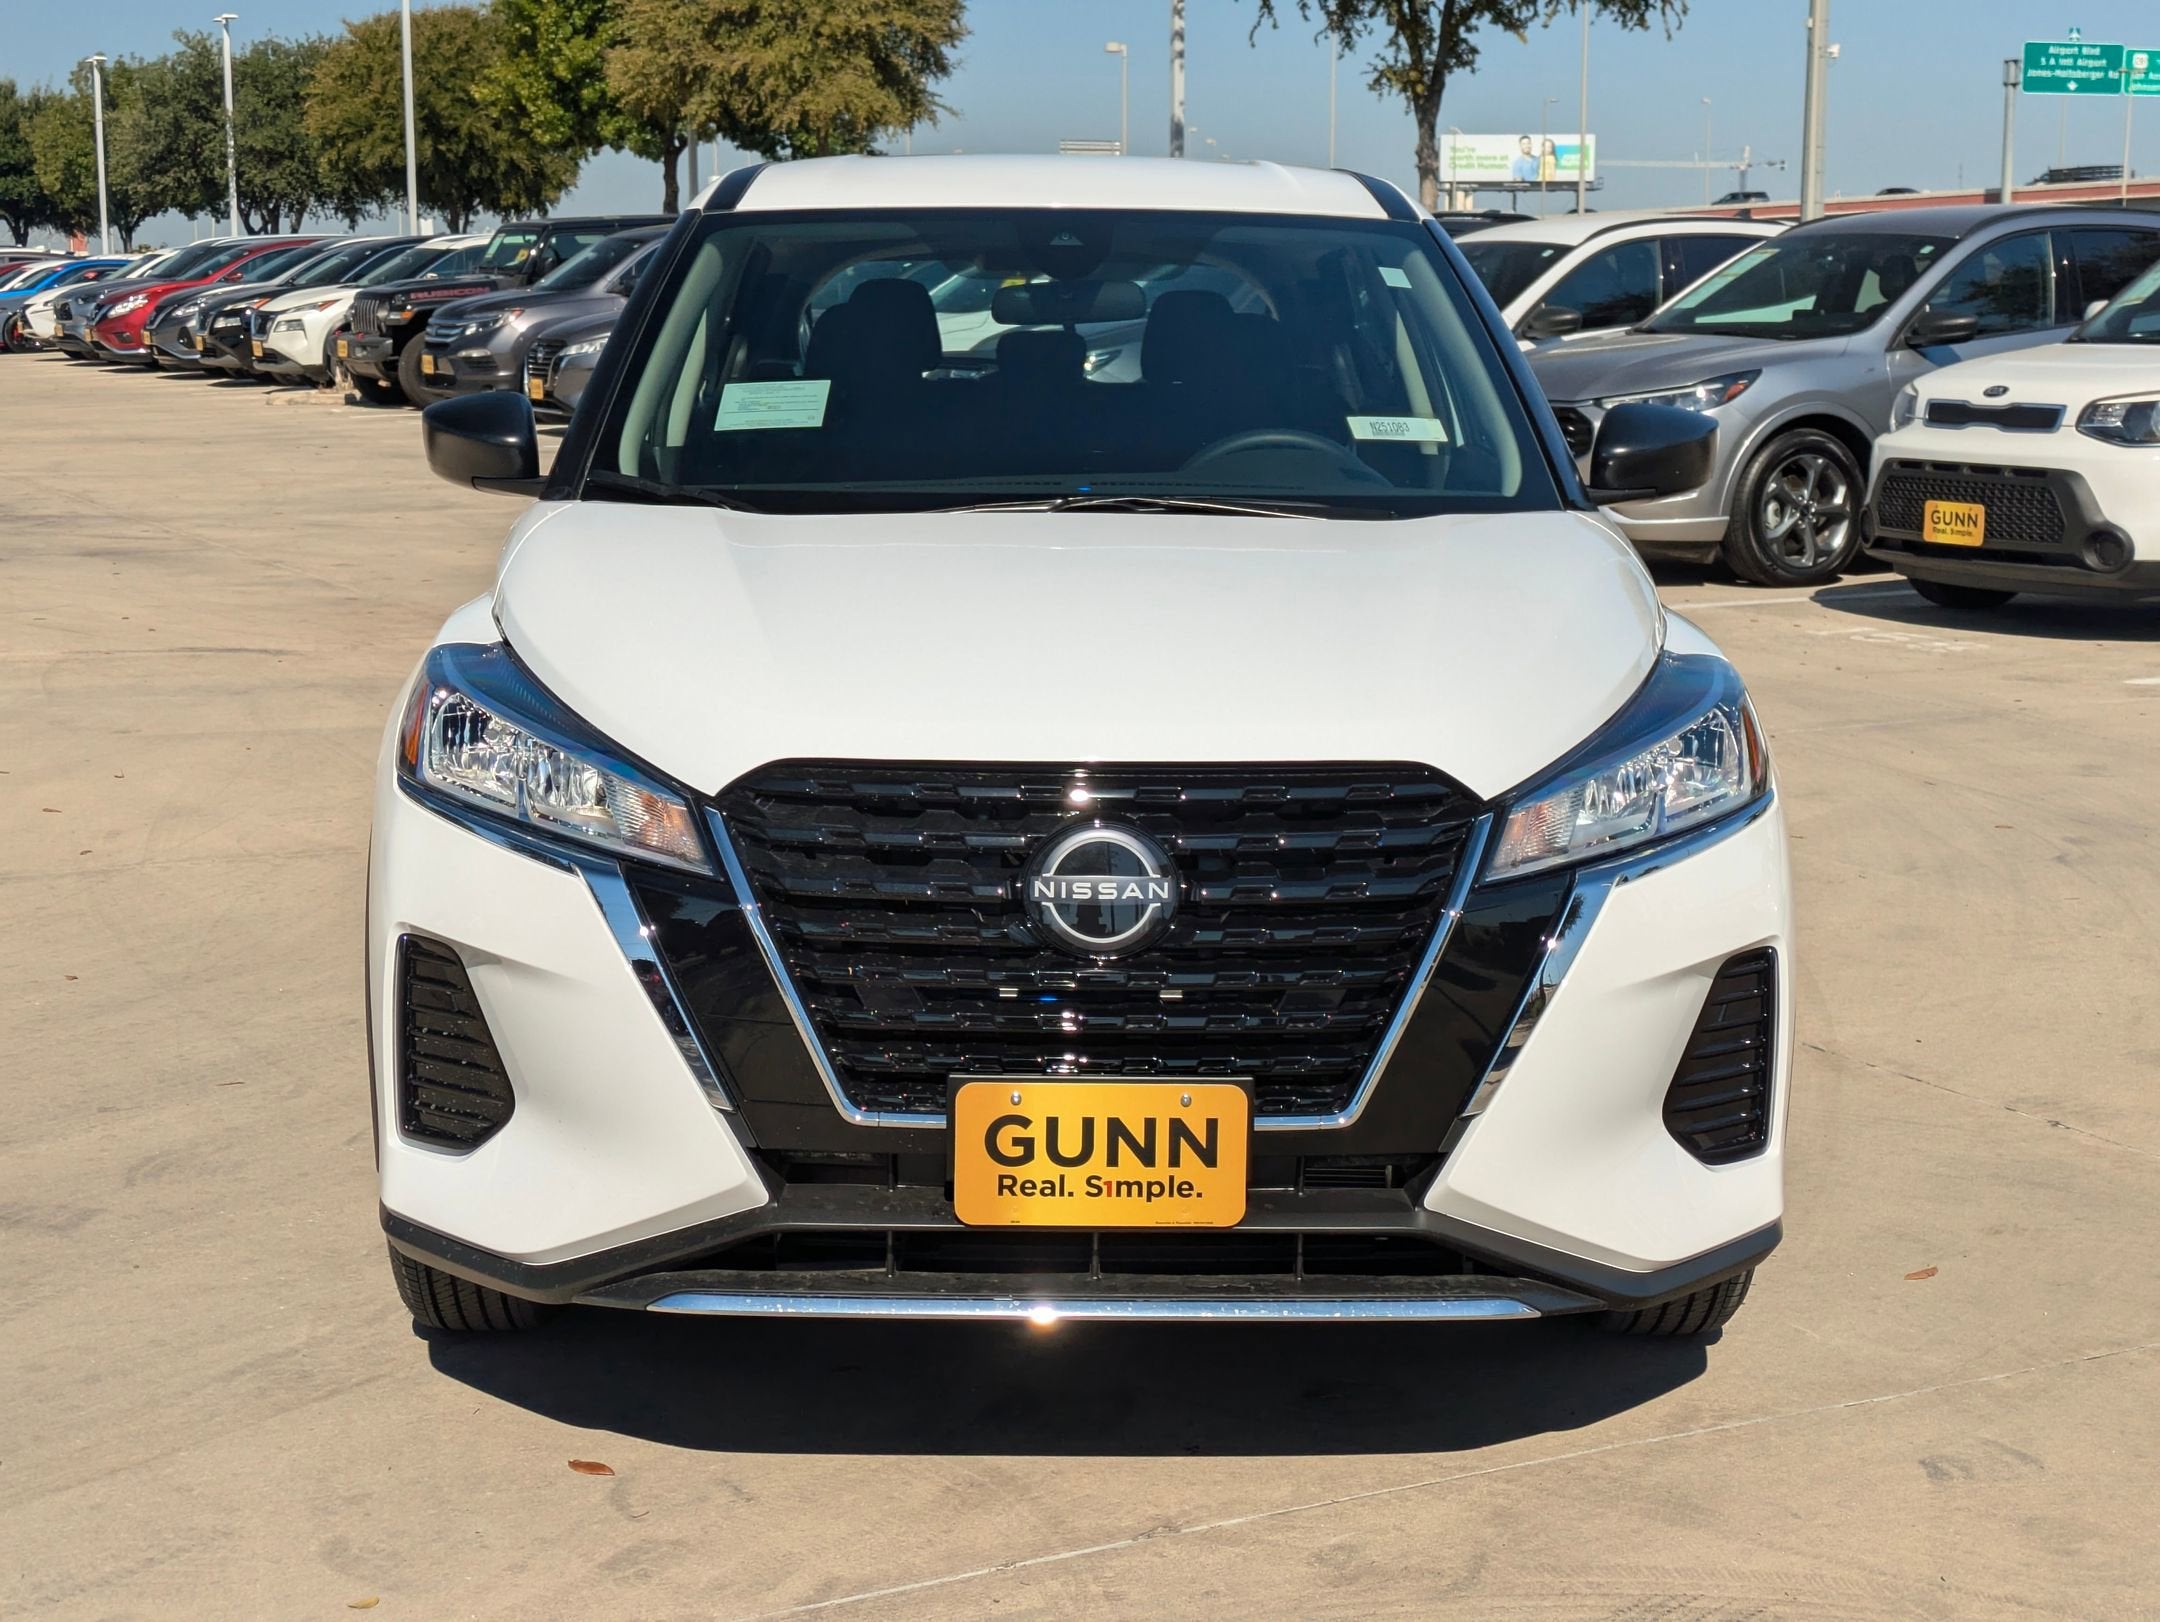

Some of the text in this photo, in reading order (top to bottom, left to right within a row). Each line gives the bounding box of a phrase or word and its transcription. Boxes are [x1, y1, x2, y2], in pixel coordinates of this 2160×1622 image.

[2048, 45, 2079, 56] Airport
[2049, 57, 2056, 66] A
[2076, 58, 2107, 68] Airport
[410, 286, 490, 299] RUBICON
[1931, 509, 1978, 528] GUNN
[1034, 880, 1169, 900] NISSAN
[984, 1114, 1219, 1169] GUNN
[997, 1174, 1075, 1198] Real.
